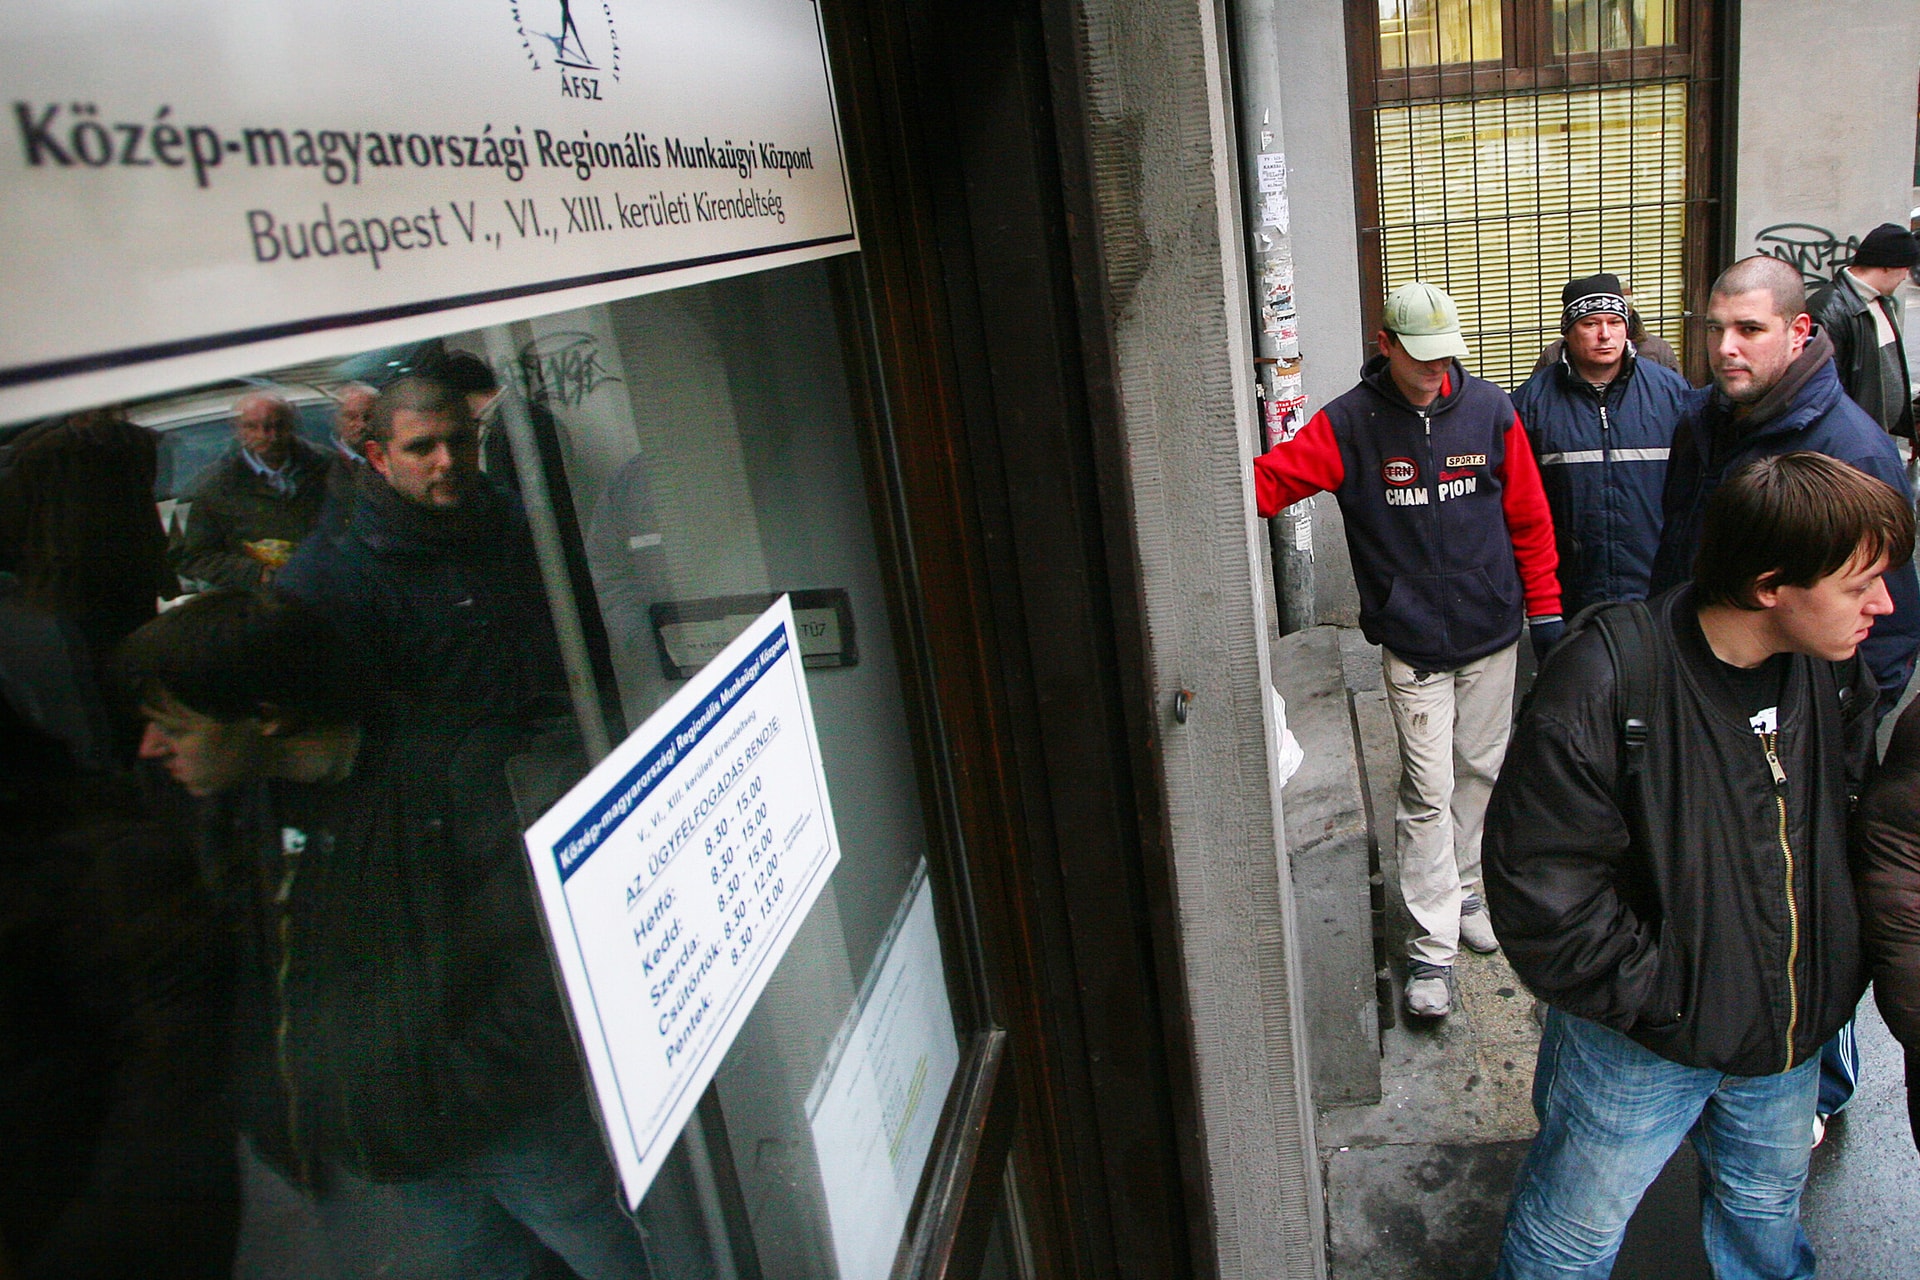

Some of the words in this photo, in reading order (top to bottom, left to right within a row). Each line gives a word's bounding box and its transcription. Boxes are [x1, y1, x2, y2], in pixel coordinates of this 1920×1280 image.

[14, 101, 530, 189] Közép-magyarországi
[534, 129, 661, 181] Regionális
[664, 137, 758, 179] Munkaügyi
[758, 142, 814, 178] Központ
[561, 67, 603, 101] ÁFSZ
[247, 202, 448, 270] Budapest
[451, 200, 500, 250] V.,
[505, 199, 558, 244] VI.,
[561, 197, 613, 234] XIII.
[615, 191, 691, 229] kerületi
[694, 188, 786, 225] Kirendeltség
[1385, 488, 1429, 505] CHAM
[1438, 477, 1477, 502] PION
[558, 741, 677, 869] Közép-magyarországi
[676, 700, 720, 750] Regionális
[719, 661, 760, 706] Munkaügyi
[759, 633, 787, 666] Központ
[705, 817, 728, 856] 8.30
[736, 775, 762, 816] 15.00
[625, 874, 645, 905] AZ
[648, 755, 744, 877] ÜGYFÉLFOGADÁS
[641, 917, 684, 978] Kedd:
[710, 846, 734, 885] 8.30
[742, 802, 767, 843] 15.00
[650, 933, 701, 1007] Szerda:
[717, 873, 740, 912] 8.30
[748, 827, 772, 868] 15.00
[658, 939, 724, 1037] Csütörtök:
[723, 900, 746, 940] 8.30
[753, 853, 778, 895] 12.00
[664, 991, 713, 1067] Péntek:
[731, 926, 753, 966] 8.30
[759, 877, 784, 920] 13.00
